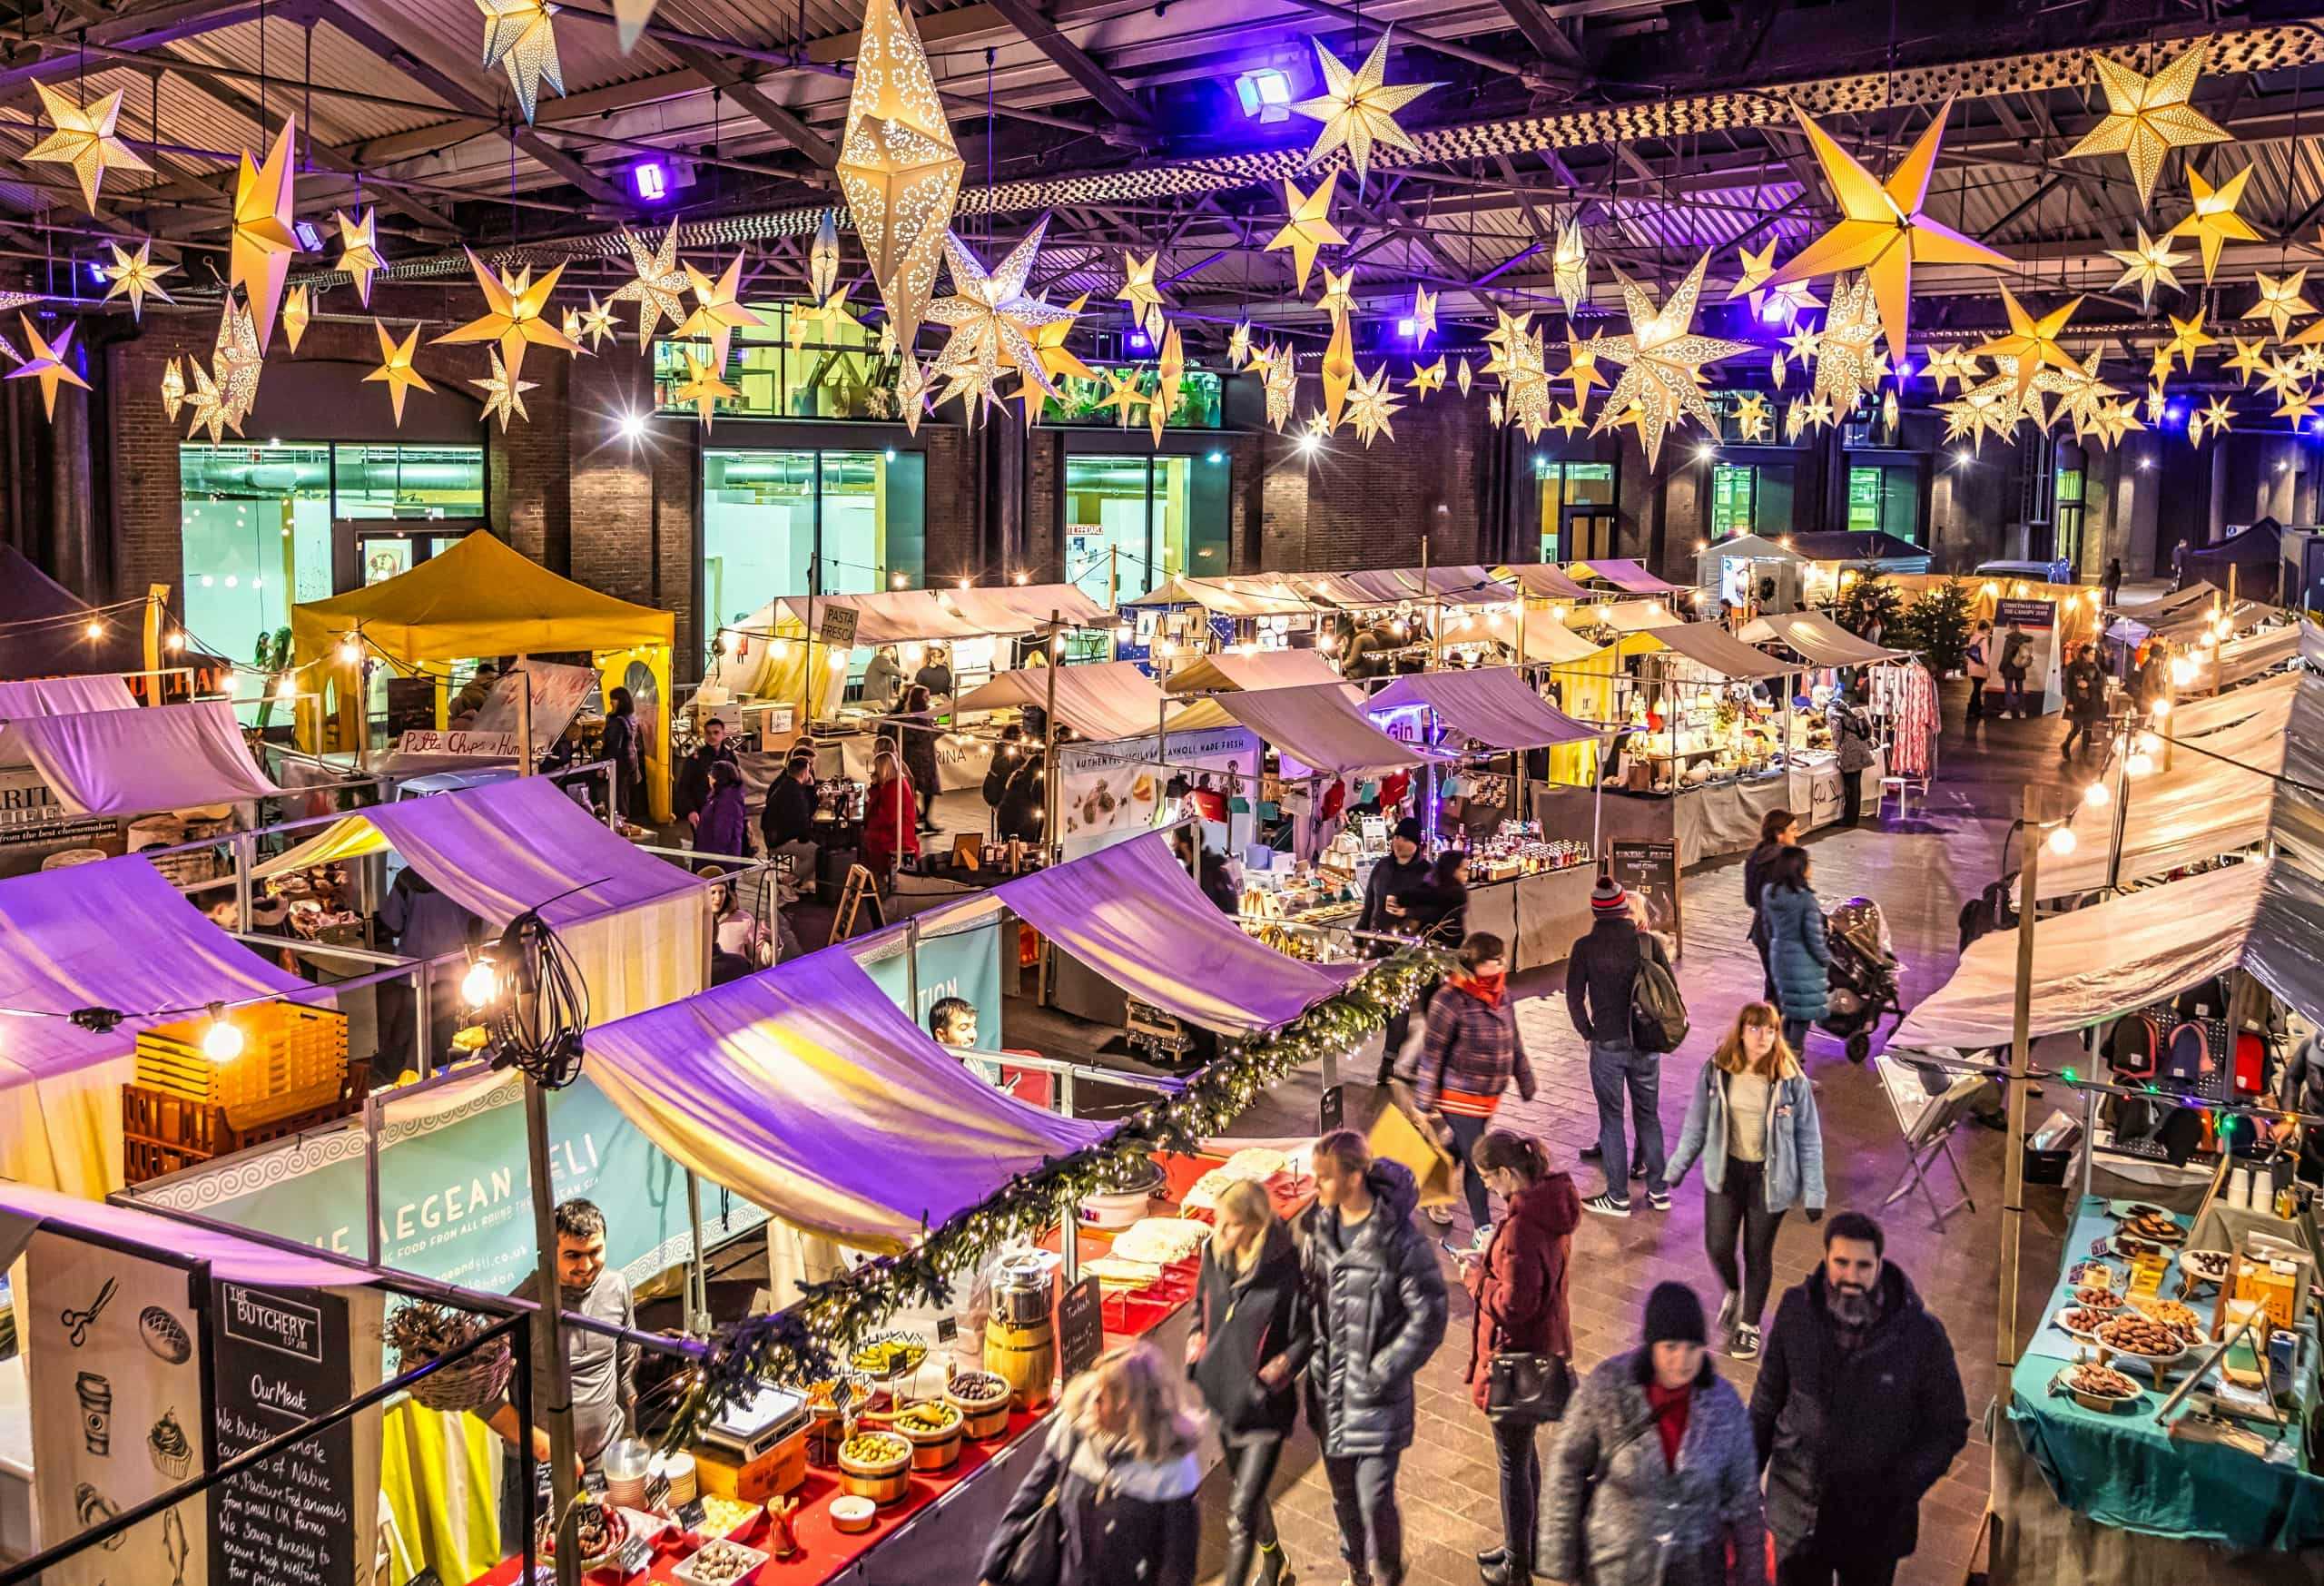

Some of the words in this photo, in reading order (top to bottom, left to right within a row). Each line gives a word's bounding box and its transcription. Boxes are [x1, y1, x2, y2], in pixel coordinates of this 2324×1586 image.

[822, 625, 853, 641] FRESCA
[828, 609, 853, 626] PASTA
[1387, 722, 1413, 740] Gin
[0, 834, 20, 844] from
[23, 831, 37, 842] the
[39, 828, 55, 839] best
[397, 1240, 427, 1258] FOOD
[459, 1219, 479, 1235] ALL
[230, 1286, 248, 1302] THE
[237, 1301, 307, 1340] BUTCHERY
[251, 1374, 273, 1402] Our
[273, 1380, 307, 1410] Meat
[217, 1407, 233, 1433] We
[236, 1415, 277, 1442] butch
[272, 1456, 285, 1480] of
[291, 1461, 332, 1492] Native
[222, 1490, 242, 1512] from
[245, 1501, 271, 1521] small
[274, 1503, 290, 1526] UK
[243, 1471, 282, 1502] Pasture
[284, 1487, 301, 1507] Fed
[302, 1498, 348, 1524] animals
[218, 1512, 237, 1534] We
[277, 1532, 316, 1569] directly
[319, 1545, 330, 1565] to
[224, 1541, 255, 1561] ensure
[260, 1546, 280, 1574] high
[229, 1557, 250, 1580] fair
